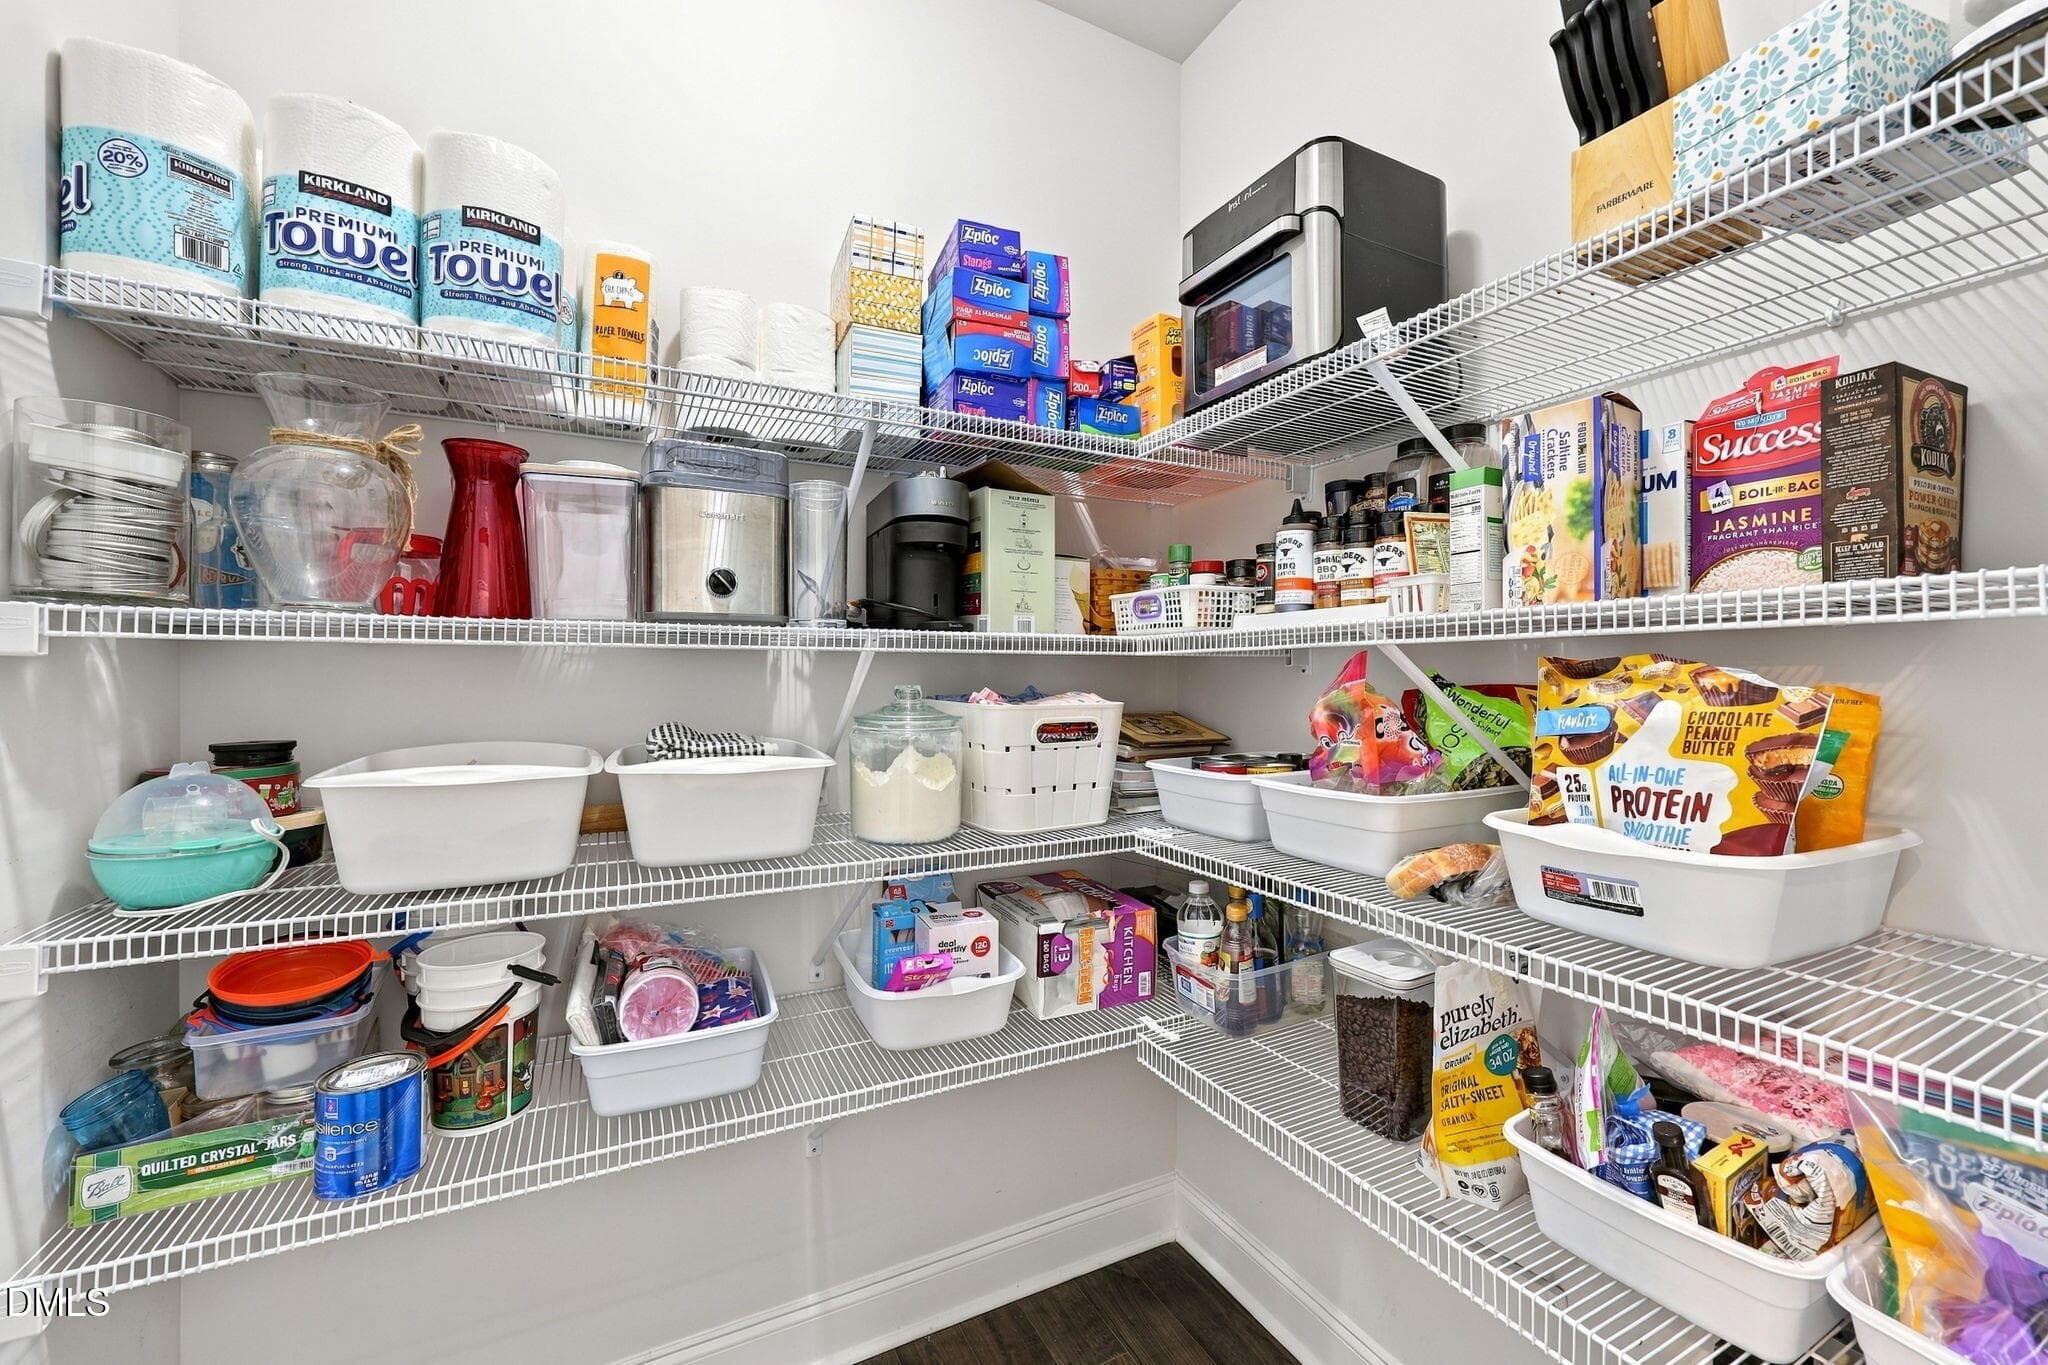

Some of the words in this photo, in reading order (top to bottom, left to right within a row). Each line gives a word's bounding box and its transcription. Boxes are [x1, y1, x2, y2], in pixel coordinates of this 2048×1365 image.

[102, 149, 144, 168] 20%
[173, 159, 229, 187] KIRKLAND
[303, 173, 389, 207] KIRKLAND
[1596, 179, 1655, 214] FARBERWARE
[466, 207, 538, 237] KIRKLAND
[963, 226, 1000, 246] Ziploc
[264, 210, 418, 287] Towel
[314, 264, 341, 276] Thick
[345, 271, 363, 281] and
[963, 254, 992, 271] Storage
[429, 244, 561, 312] Towel
[974, 277, 1012, 299] Ziploc
[1034, 261, 1048, 301] Ziploc
[475, 293, 497, 304] Thick
[500, 299, 516, 308] and
[595, 325, 615, 336] PAPER
[617, 327, 645, 342] TOWELS
[1033, 325, 1048, 366] Ziploc
[974, 348, 1010, 368] Ziploc
[961, 378, 995, 396] Ziploc
[1073, 383, 1089, 393] 200
[1834, 369, 1878, 389] KODIAK
[1770, 381, 1821, 400] JASMIN
[1785, 392, 1808, 402] RICE
[1098, 406, 1128, 424] Ziploc
[1577, 421, 1587, 446] FOOD
[1667, 428, 1676, 440] 8
[1699, 420, 1822, 465] Success
[1522, 440, 1539, 476] Original
[1546, 428, 1559, 480] Crackers
[1559, 431, 1571, 472] Saltine
[1920, 447, 1951, 475] KODIAK
[1577, 455, 1587, 475] LION
[1714, 487, 1724, 498] 4
[1909, 489, 1935, 504] POWER
[1711, 499, 1732, 509] BAGS
[1712, 507, 1813, 533] JASMINE
[1706, 529, 1759, 542] FRAGRANT
[1763, 526, 1787, 535] THAI
[1792, 523, 1818, 532] RICE
[1860, 541, 1885, 553] WILD
[1277, 562, 1296, 570] BBQ
[1316, 564, 1338, 573] BBQ
[1446, 688, 1512, 730] Wonderful
[1687, 711, 1773, 727] CHOCOLATE
[1685, 726, 1742, 741] PEANUT
[1682, 740, 1736, 757] BUTTER
[1608, 763, 1686, 787] ALL-IN-ONE
[1567, 793, 1591, 803] PROTEIN
[1610, 785, 1713, 825] PROTEIN
[1623, 820, 1692, 846] SMOOTHIE
[1064, 878, 1122, 907] KITCHEN
[937, 939, 957, 949] deal
[938, 945, 968, 955] worthy
[974, 941, 988, 949] 120
[1057, 943, 1071, 963] 13
[1042, 953, 1050, 974] BAGS
[1122, 926, 1134, 985] KITCHEN
[1440, 994, 1495, 1034] purely
[1444, 1052, 1473, 1070] ORGANIC
[1489, 1056, 1502, 1071] 34
[1502, 1048, 1516, 1063] OZ
[1440, 1075, 1480, 1098] ORIGINAL
[1440, 1085, 1506, 1112] SALTY-SWEET
[1441, 1112, 1477, 1127] GRANOLA
[141, 1154, 197, 1177] QUILTED
[200, 1143, 258, 1164] CRYSTAL
[264, 1133, 297, 1151] JARS
[87, 1174, 126, 1199] Ball
